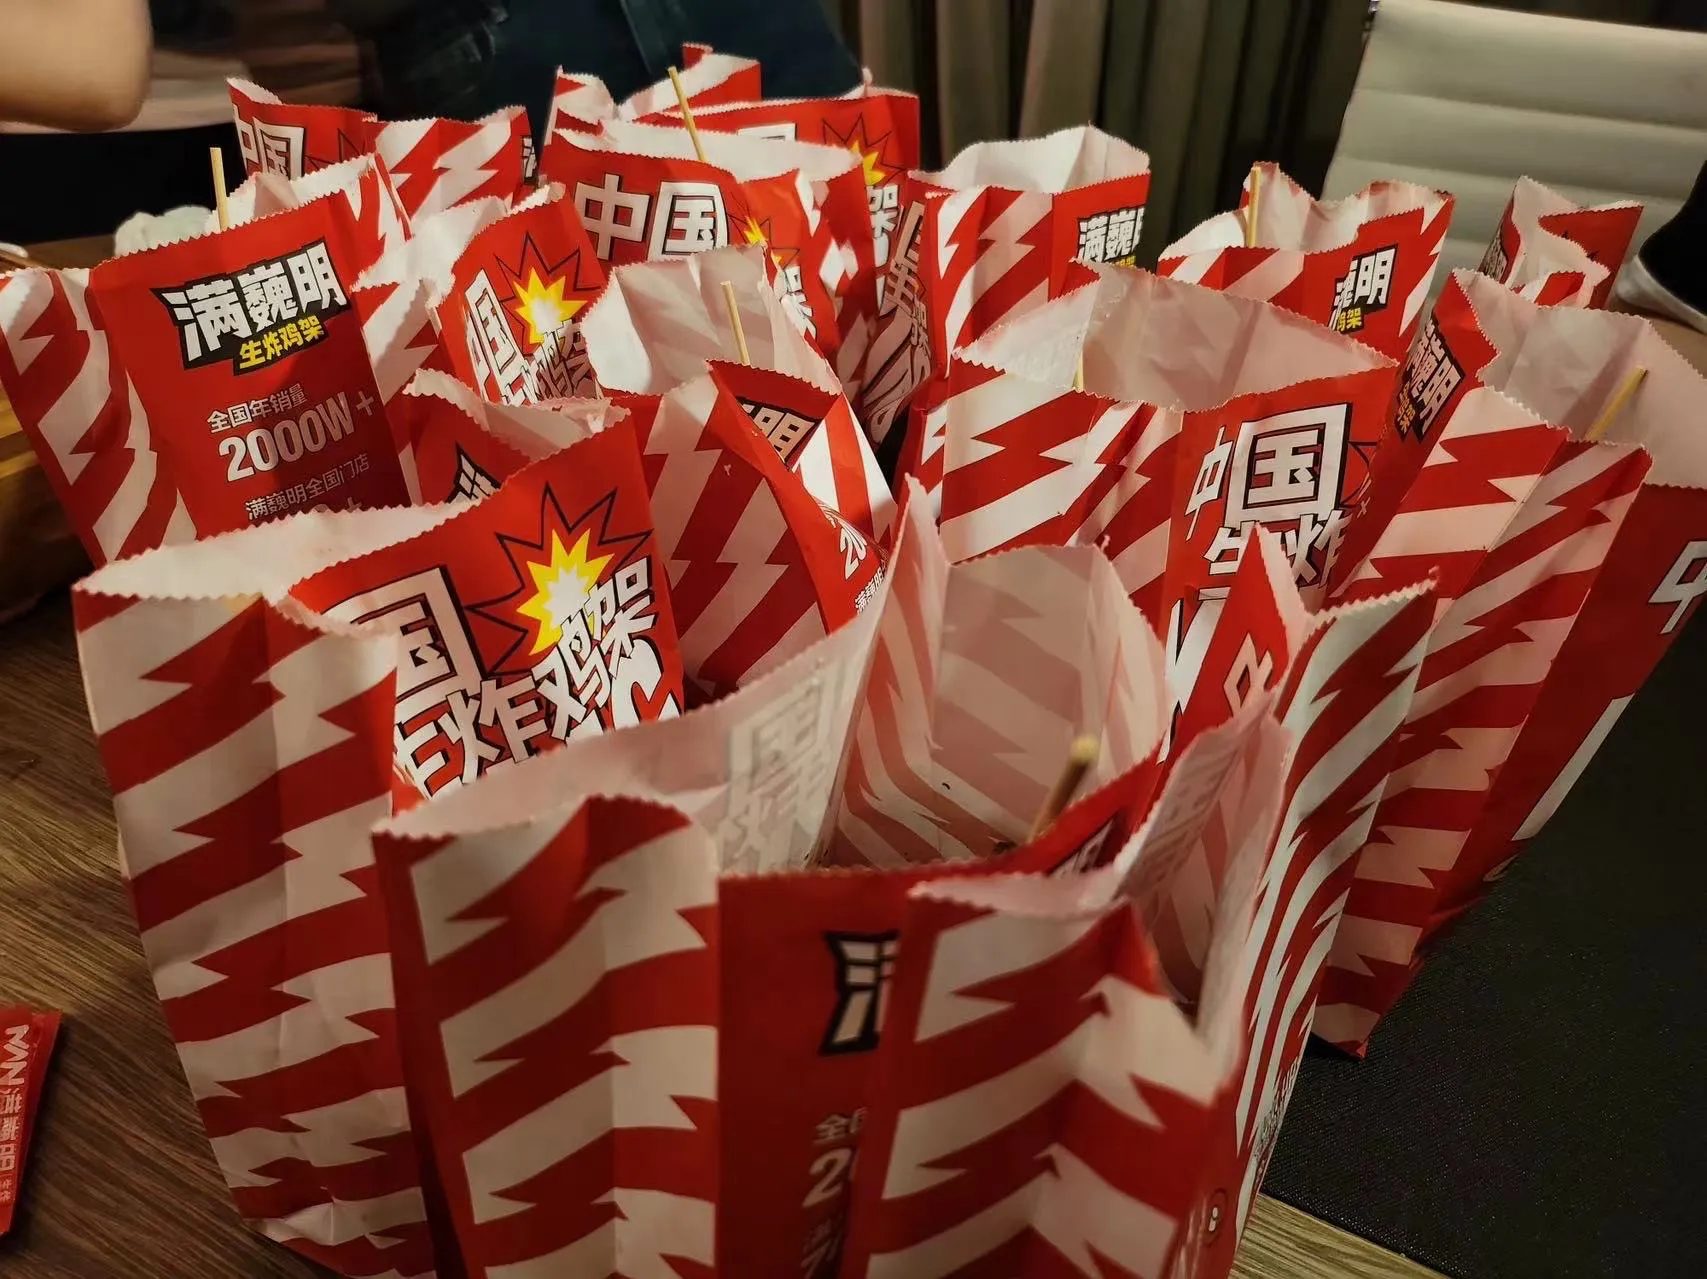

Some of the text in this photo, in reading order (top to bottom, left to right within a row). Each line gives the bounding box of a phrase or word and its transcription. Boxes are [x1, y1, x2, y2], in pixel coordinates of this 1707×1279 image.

[575, 173, 730, 262] 中国
[162, 240, 348, 362] 满巍明
[238, 315, 325, 369] 生炸鸡架
[206, 383, 308, 434] 全国年销量
[245, 453, 371, 520] 满巍明全国门店
[1184, 403, 1348, 542] 中国
